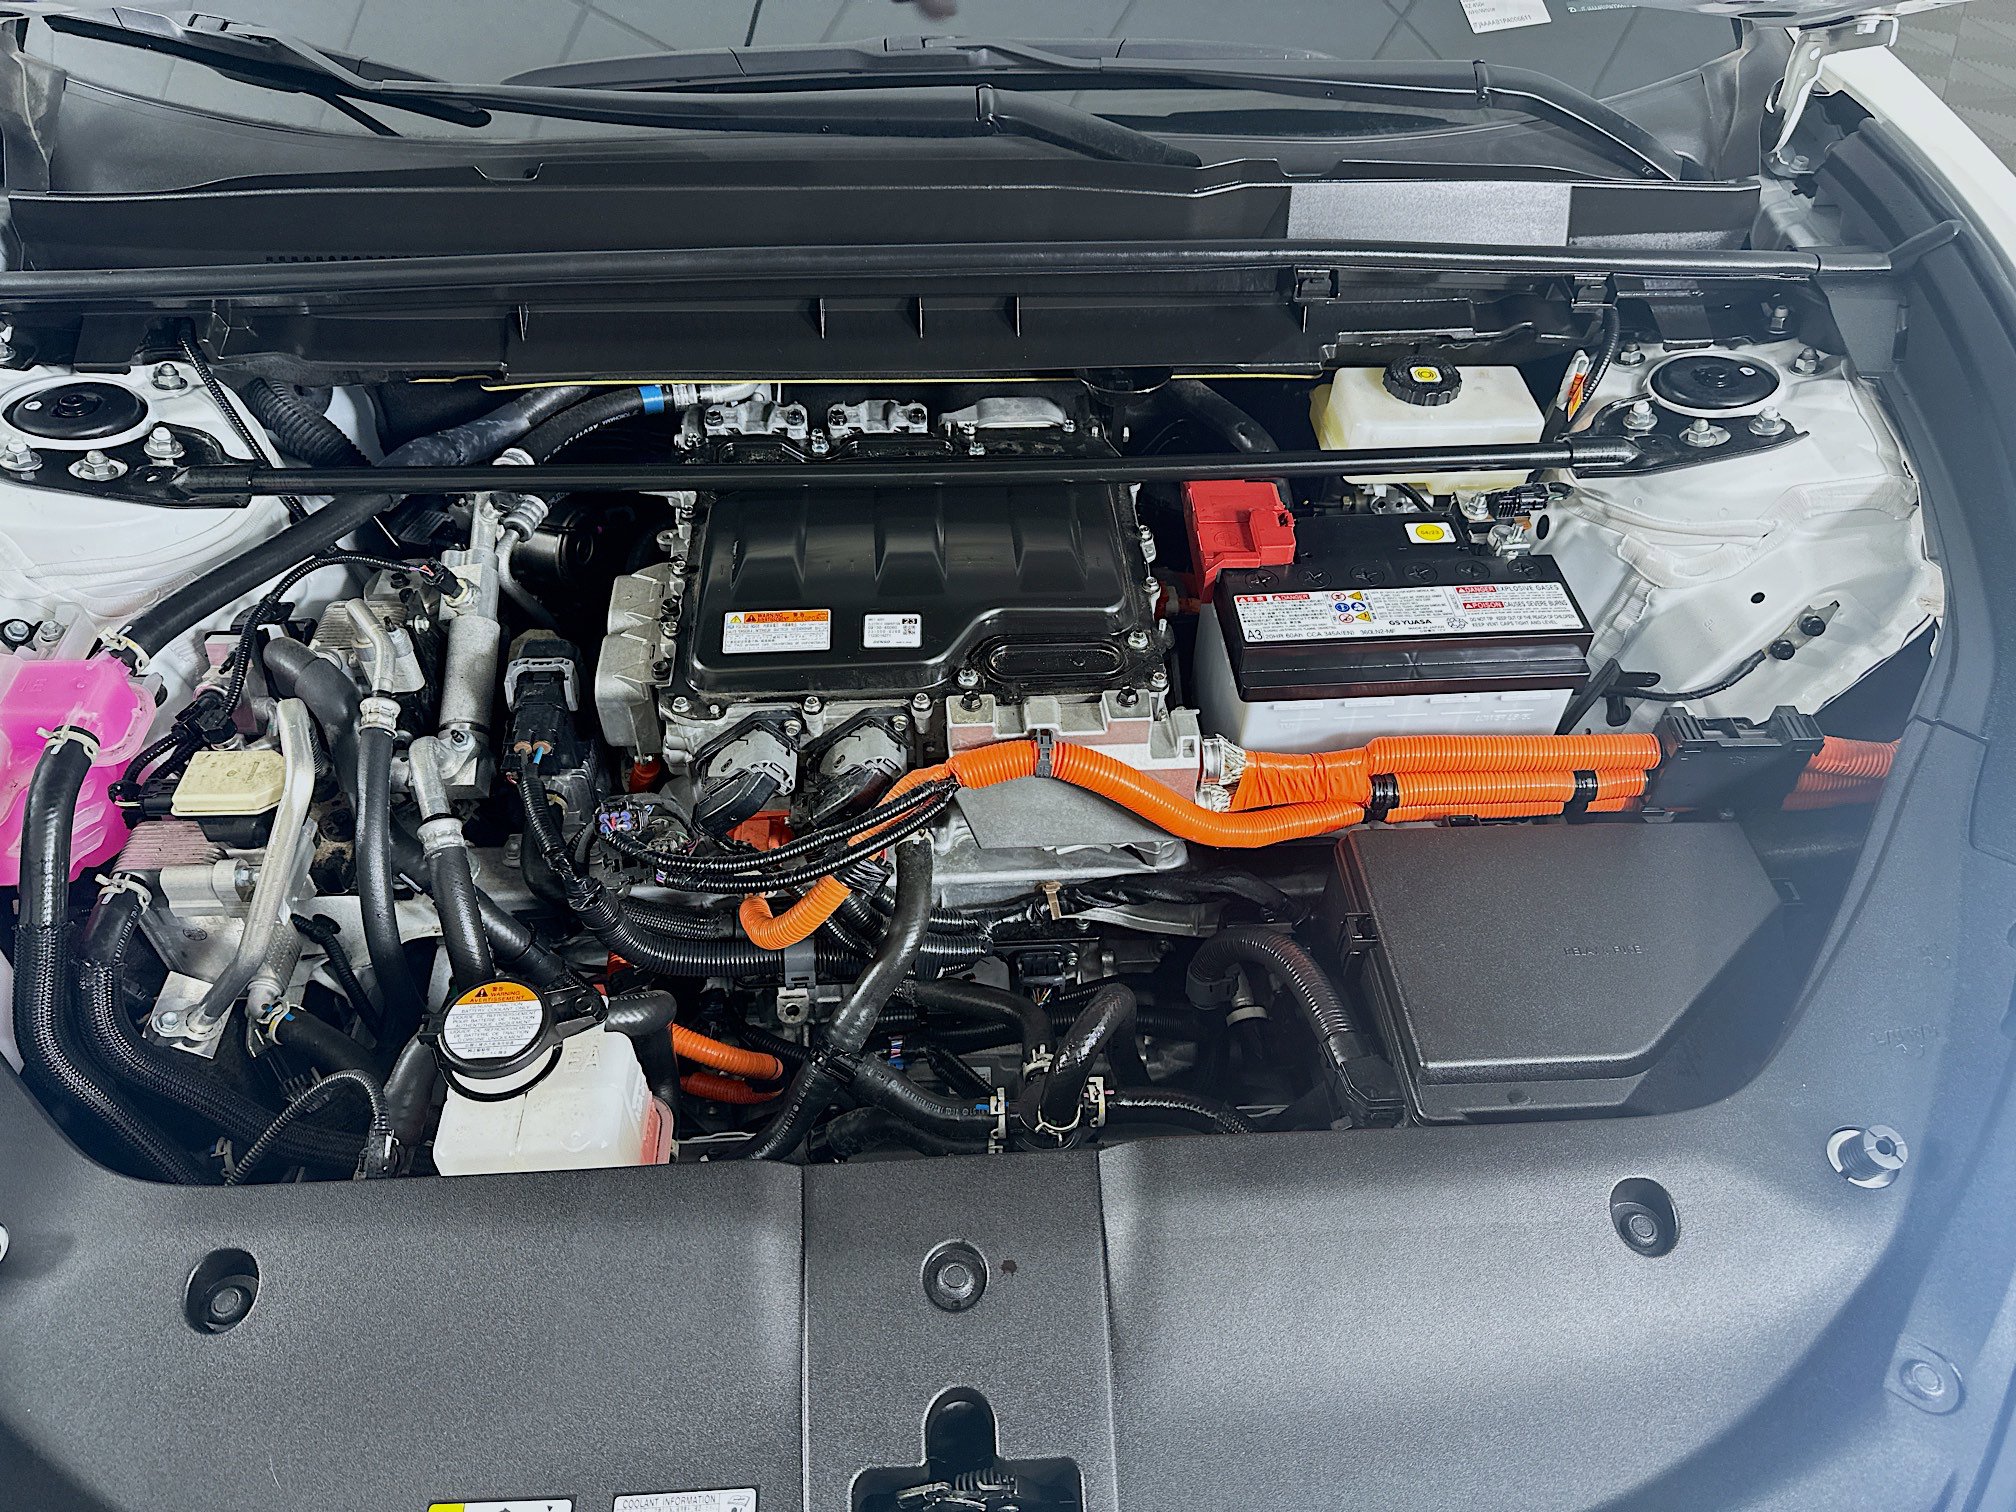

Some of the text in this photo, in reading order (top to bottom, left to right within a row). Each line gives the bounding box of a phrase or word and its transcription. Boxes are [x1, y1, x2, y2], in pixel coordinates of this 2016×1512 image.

[1248, 630, 1262, 640] A3
[623, 1495, 715, 1509] COOLANT INFORMATION
